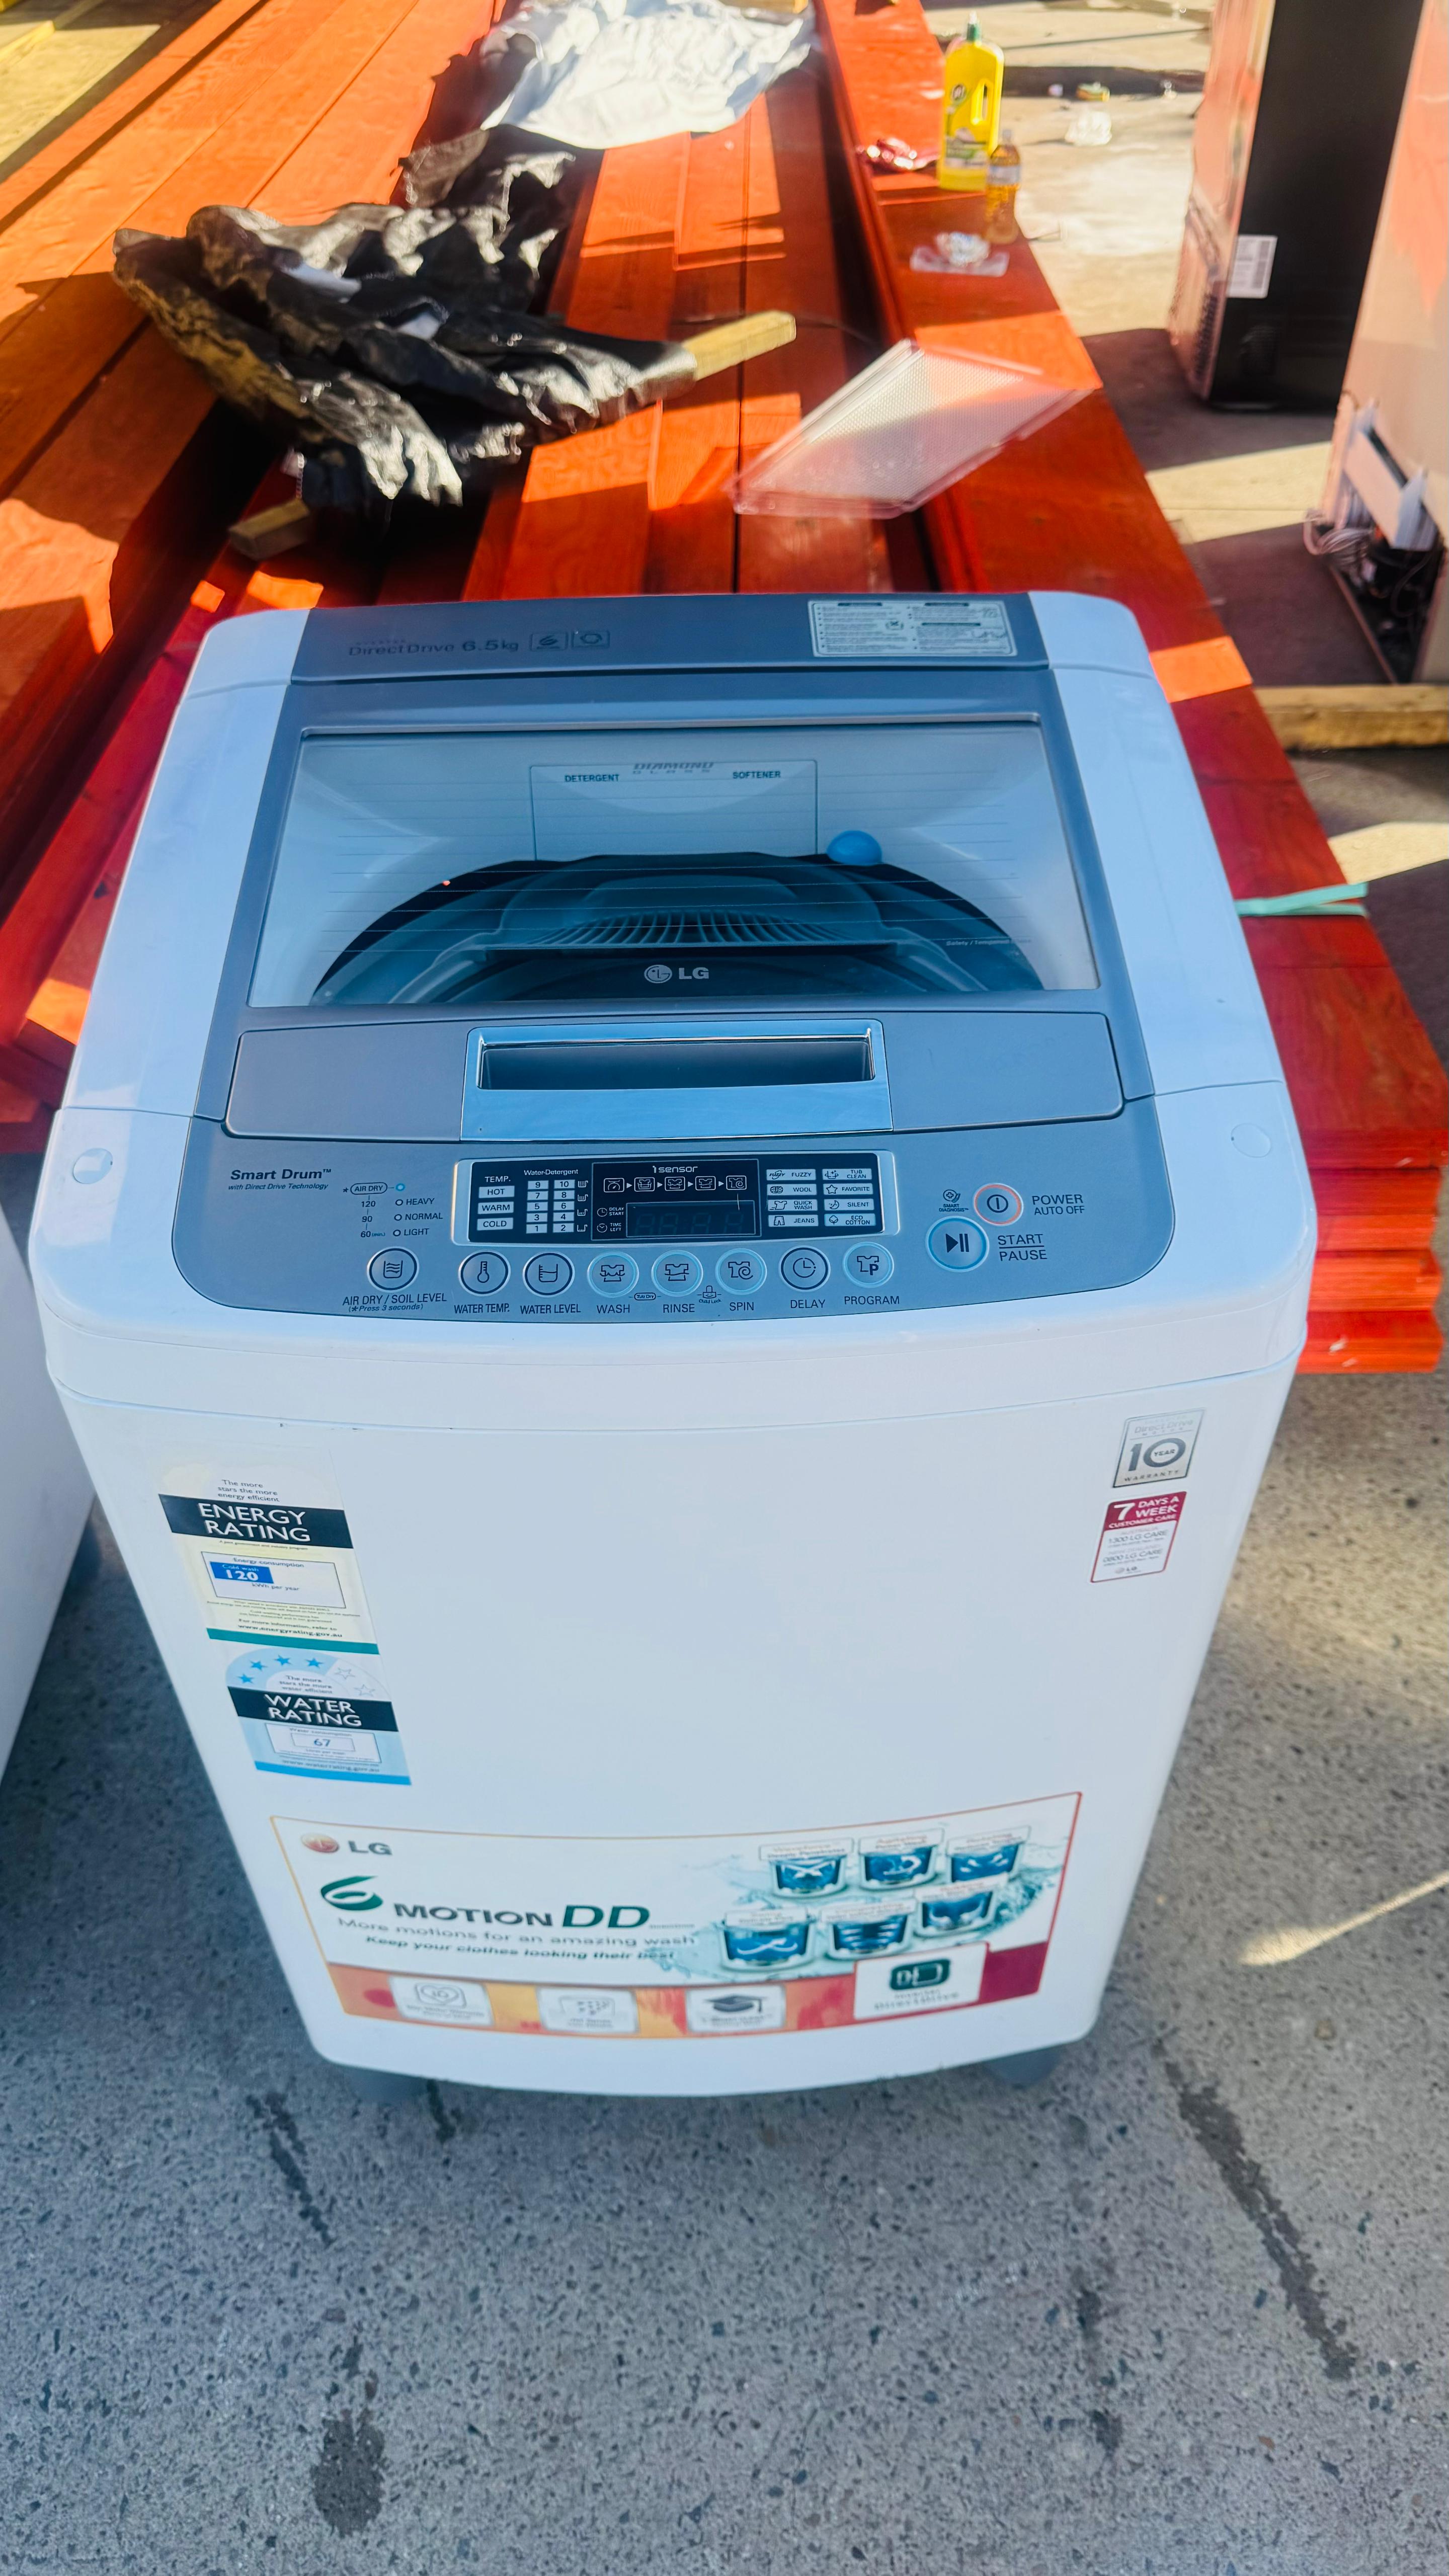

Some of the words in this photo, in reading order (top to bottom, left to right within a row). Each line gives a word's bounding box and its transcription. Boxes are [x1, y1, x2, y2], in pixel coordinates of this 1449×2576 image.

[564, 774, 619, 783] DETERGENT
[732, 770, 781, 779] SOFTENER
[678, 967, 709, 980] LG
[230, 1169, 277, 1180] Smart
[288, 1182, 329, 1190] Technology
[1031, 1194, 1084, 1205] POWER
[481, 1203, 511, 1212] WARM
[1033, 1206, 1064, 1216] AUTO
[1065, 1205, 1085, 1214] OFF
[405, 1213, 443, 1221] NORMAL
[404, 1228, 430, 1236] LIGHT
[997, 1233, 1044, 1245] START
[999, 1249, 1048, 1262] PAUSE
[342, 1297, 360, 1306] AIR
[361, 1295, 383, 1305] DRY
[391, 1294, 415, 1304] SOIL
[417, 1293, 447, 1303] LEVEL
[790, 1299, 826, 1309] DELAY
[844, 1296, 900, 1305] PROGRAM
[454, 1304, 485, 1315] WATER
[485, 1303, 510, 1313] TEMP.
[520, 1305, 552, 1315] WATER
[553, 1304, 581, 1314] LEVEL
[597, 1304, 630, 1314] WASH
[663, 1304, 695, 1313] RINSE
[729, 1302, 755, 1311] SPIN
[1128, 1438, 1186, 1472] 10
[1154, 1449, 1176, 1457] YEAR
[1124, 1470, 1179, 1482] WARRANTY
[221, 1479, 238, 1487] The
[247, 1494, 280, 1502] efficient
[1138, 1496, 1169, 1509] DAYS
[1170, 1495, 1180, 1503] A
[198, 1502, 306, 1525] ENERGY
[1113, 1502, 1136, 1521] 7
[1135, 1504, 1178, 1518] WEEK
[204, 1519, 311, 1542] RATING
[233, 1557, 258, 1566] Energy
[259, 1560, 304, 1568] consumption
[225, 1569, 259, 1581] 120
[264, 1693, 356, 1713] WATER
[268, 1707, 362, 1727] RATING
[313, 1738, 331, 1747] 67
[348, 1840, 393, 1856] LG
[393, 1903, 554, 1928] MOTION
[562, 1904, 651, 1929] DD
[338, 1917, 389, 1932] More
[395, 1925, 477, 1940] motions
[484, 1931, 511, 1941] for
[551, 1936, 638, 1947] amazing
[643, 1936, 695, 1946] wash
[365, 1935, 409, 1948] Keep
[413, 1941, 451, 1951] your
[456, 1945, 520, 1956] clothes
[524, 1950, 588, 1959] looking
[593, 1951, 634, 1960] their
